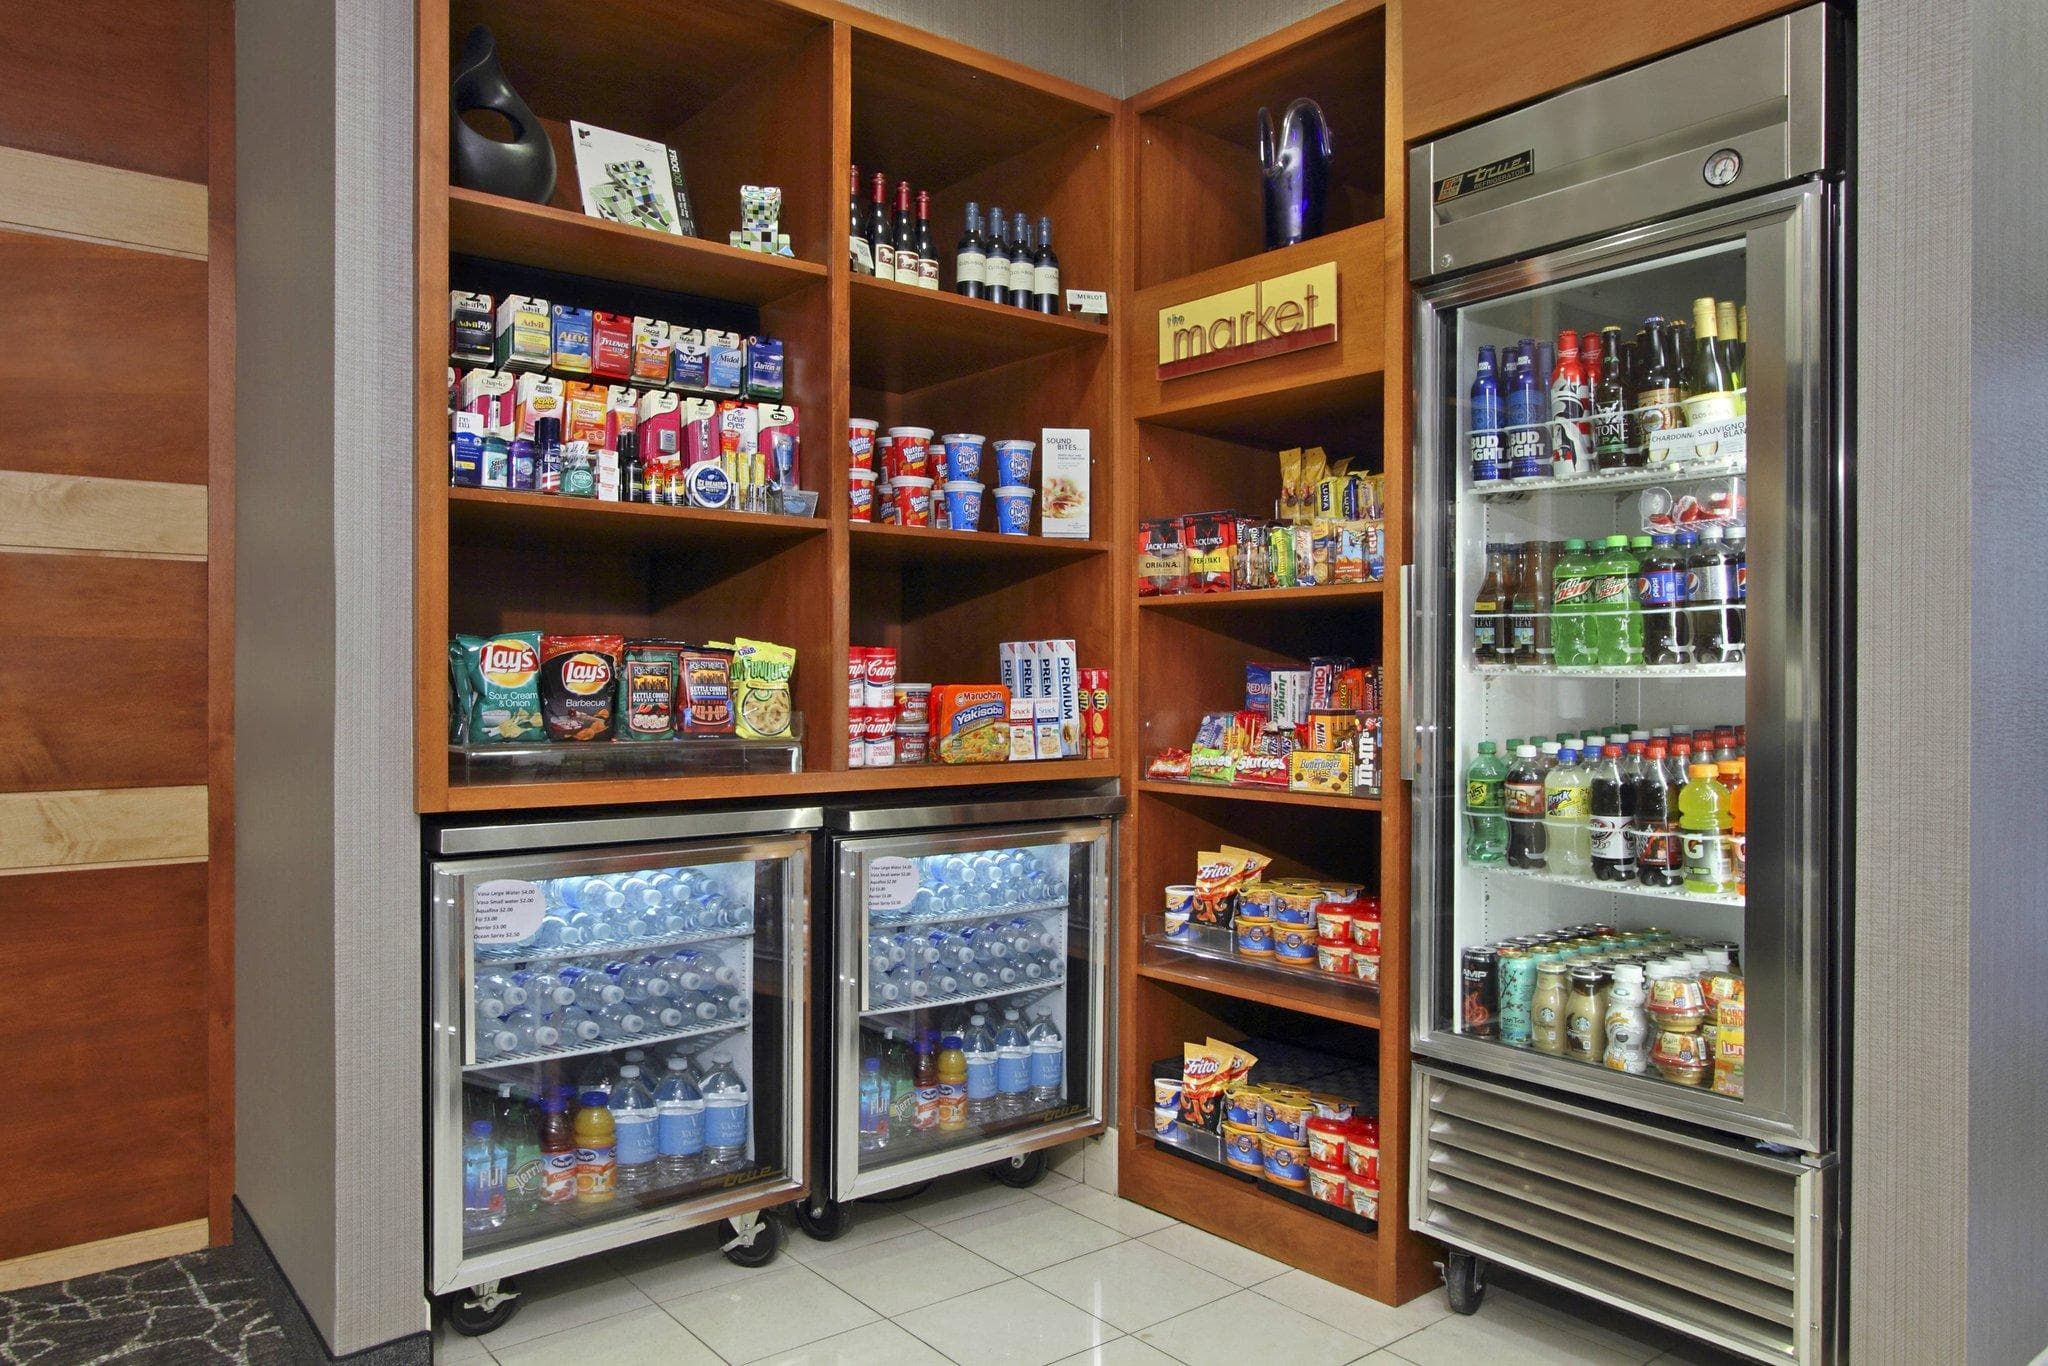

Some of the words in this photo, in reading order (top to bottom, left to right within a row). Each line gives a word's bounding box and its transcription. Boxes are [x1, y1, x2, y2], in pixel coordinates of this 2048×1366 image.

[521, 320, 545, 329] Advil
[1167, 313, 1185, 328] the
[1173, 281, 1319, 361] market
[559, 331, 589, 344] ALEVE
[600, 337, 629, 349] TYLENOL
[638, 346, 667, 357] DayQuil
[679, 355, 703, 365] NyQuil
[719, 354, 740, 363] Midol
[727, 413, 746, 423] Clear
[727, 421, 745, 430] eyes
[1698, 421, 1745, 438] SAUVIGNO
[1046, 437, 1072, 445] SOUND
[1510, 430, 1540, 446] BUD
[1651, 432, 1694, 443] CHARDONN
[1723, 430, 1746, 439] BLAN
[1471, 435, 1499, 449] BUD
[903, 446, 924, 455] Nutter
[907, 451, 925, 462] Butter
[1472, 447, 1504, 462] IGHT
[1321, 482, 1330, 510] LUNA
[1250, 527, 1260, 547] KIND
[1145, 542, 1162, 551] JACK
[1145, 561, 1182, 569] ORIGINAL
[1652, 576, 1660, 598] pepsi
[484, 645, 535, 674] Lay's
[566, 660, 607, 684] Lay's
[1023, 658, 1033, 698] PREM
[1042, 658, 1052, 698] PREM
[1060, 657, 1074, 720] PREMIUM
[1311, 667, 1326, 710] CRUNC
[489, 691, 509, 701] Sour
[510, 691, 539, 700] Cream
[964, 691, 1003, 702] Maruchan
[1093, 691, 1106, 711] RITZ
[1278, 674, 1289, 718] Junior
[506, 699, 531, 708] Onion
[565, 699, 606, 708] Barbecue
[956, 704, 1004, 726] Yakisoba
[1012, 707, 1031, 715] Snack
[1300, 758, 1341, 769] Butterfinger
[1684, 833, 1704, 859] G
[1197, 864, 1234, 879] Fritos
[1463, 968, 1489, 978] AMP
[1184, 1059, 1219, 1075] Fritos
[480, 1168, 503, 1189] FIJI
